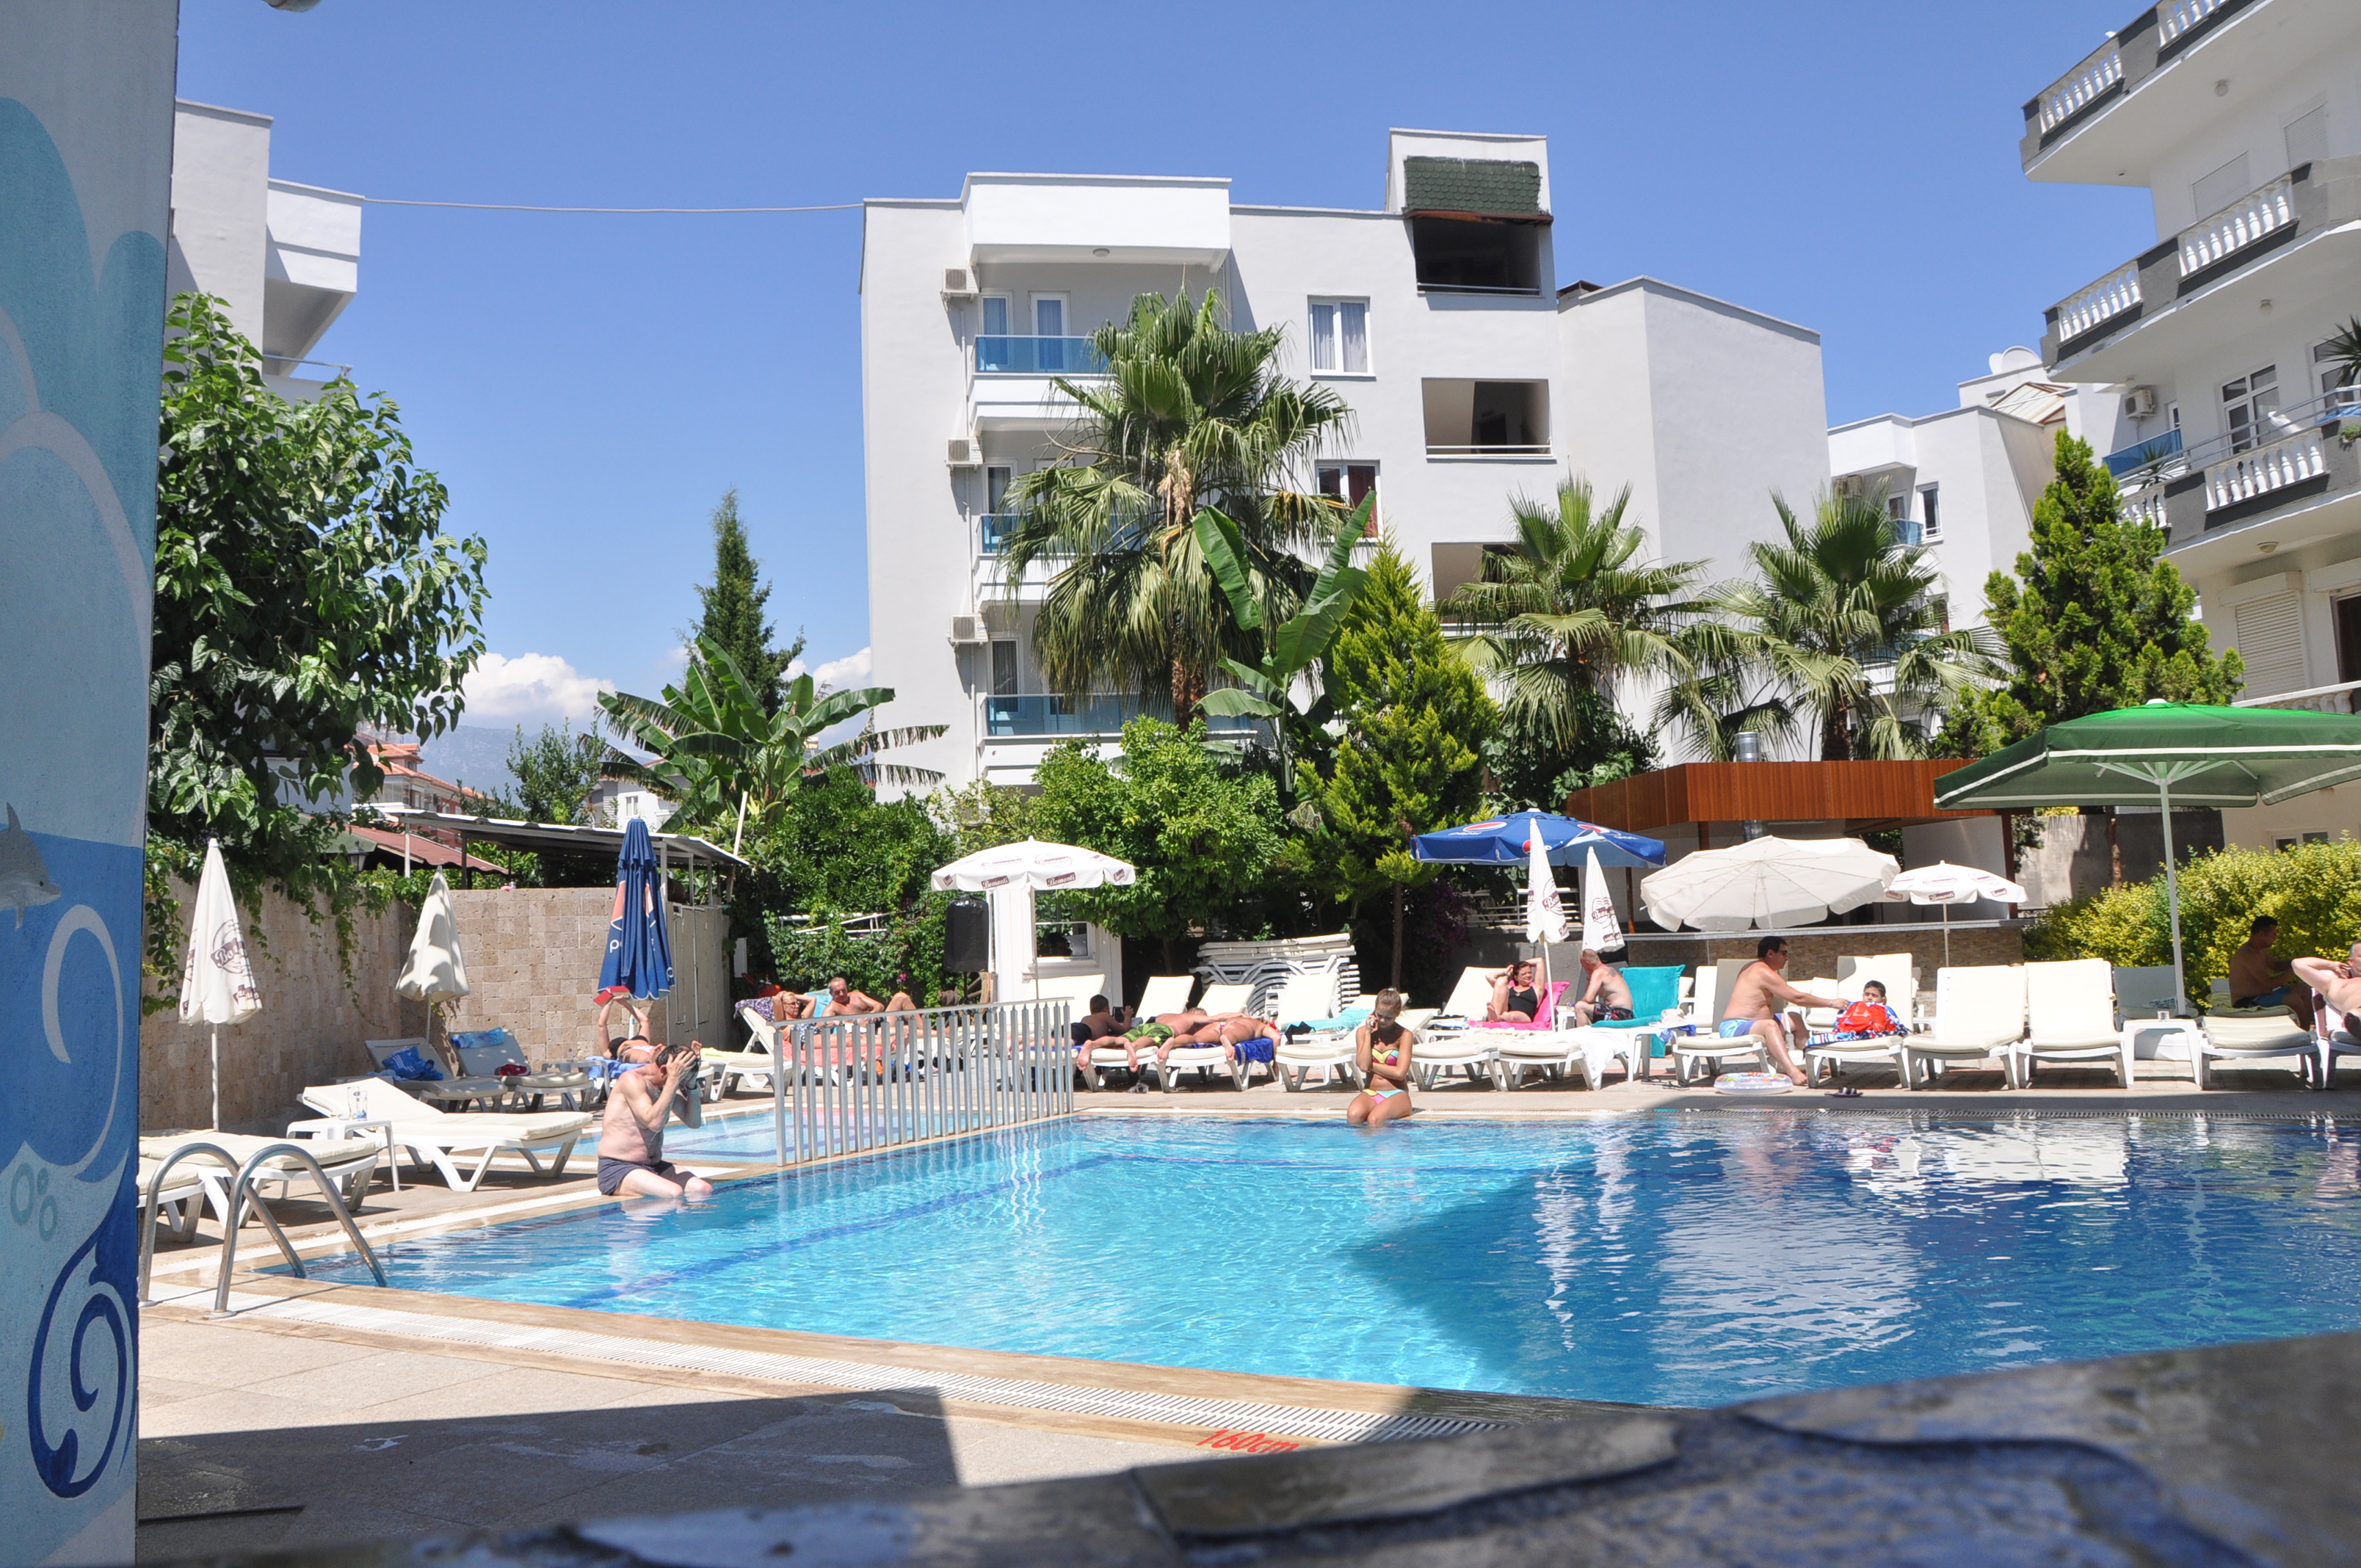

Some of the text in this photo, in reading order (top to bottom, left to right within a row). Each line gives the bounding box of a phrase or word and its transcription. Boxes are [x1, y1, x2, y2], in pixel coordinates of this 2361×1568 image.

[982, 877, 1009, 888] Bomonti
[1047, 874, 1075, 886] Bomonti
[1195, 1429, 1299, 1453] 160cm
